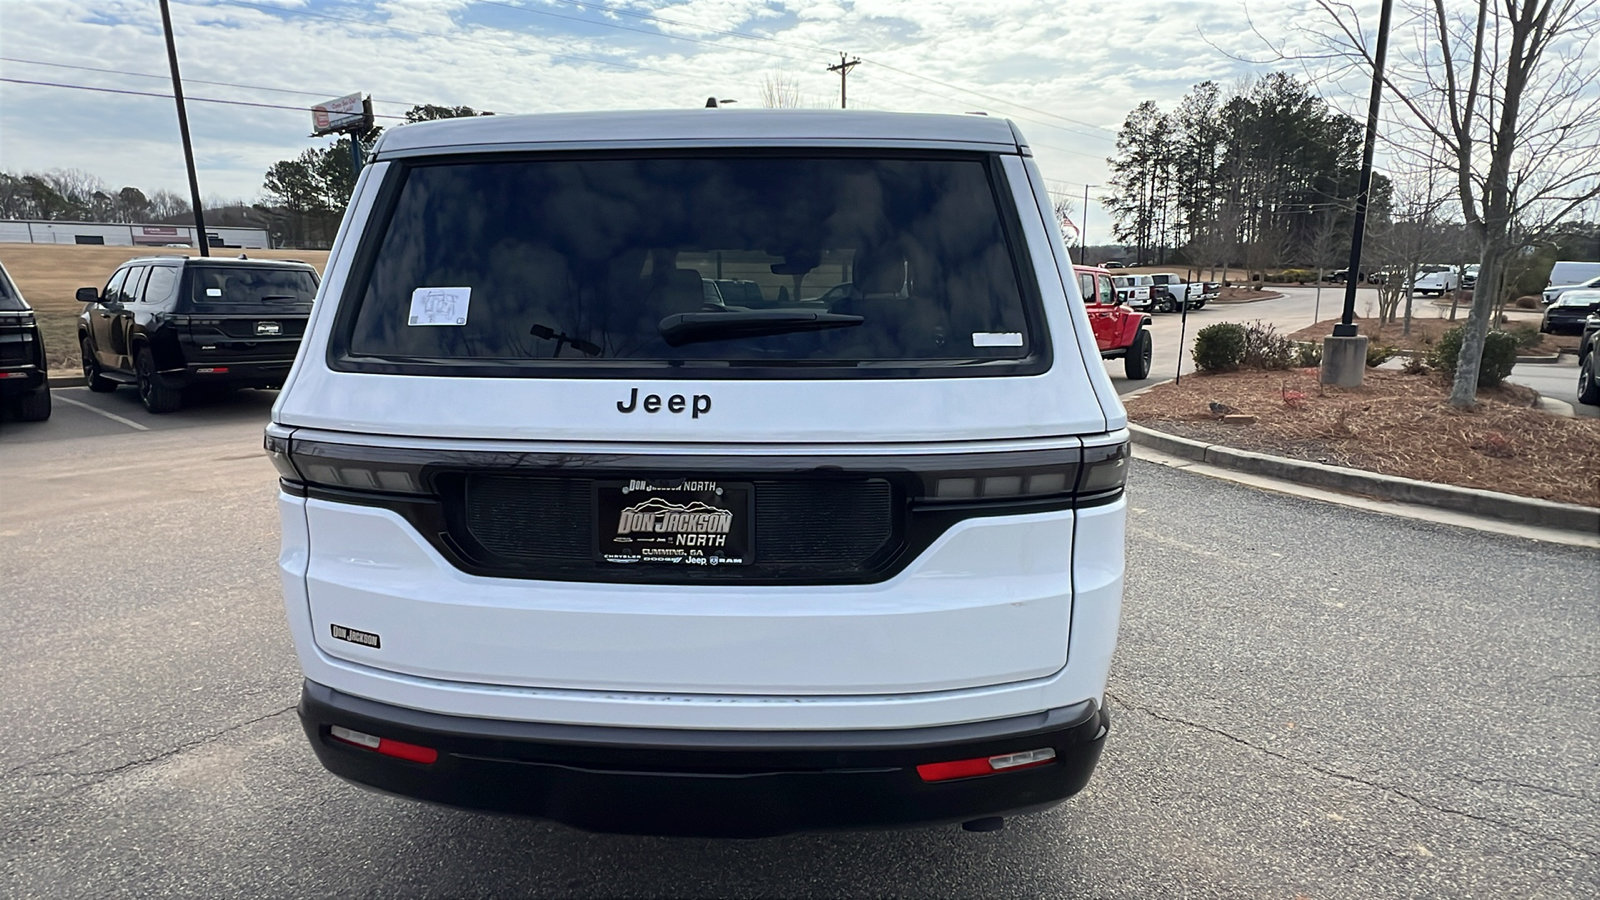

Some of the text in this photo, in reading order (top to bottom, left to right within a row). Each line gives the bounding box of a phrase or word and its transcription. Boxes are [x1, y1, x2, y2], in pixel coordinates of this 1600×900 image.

[616, 388, 711, 419] Jeep
[629, 479, 646, 491] DON
[683, 481, 716, 491] NORTH
[617, 512, 733, 534] DON JACKSON
[676, 534, 727, 546] NORTH
[685, 556, 707, 565] Jeep
[333, 625, 347, 639] DON
